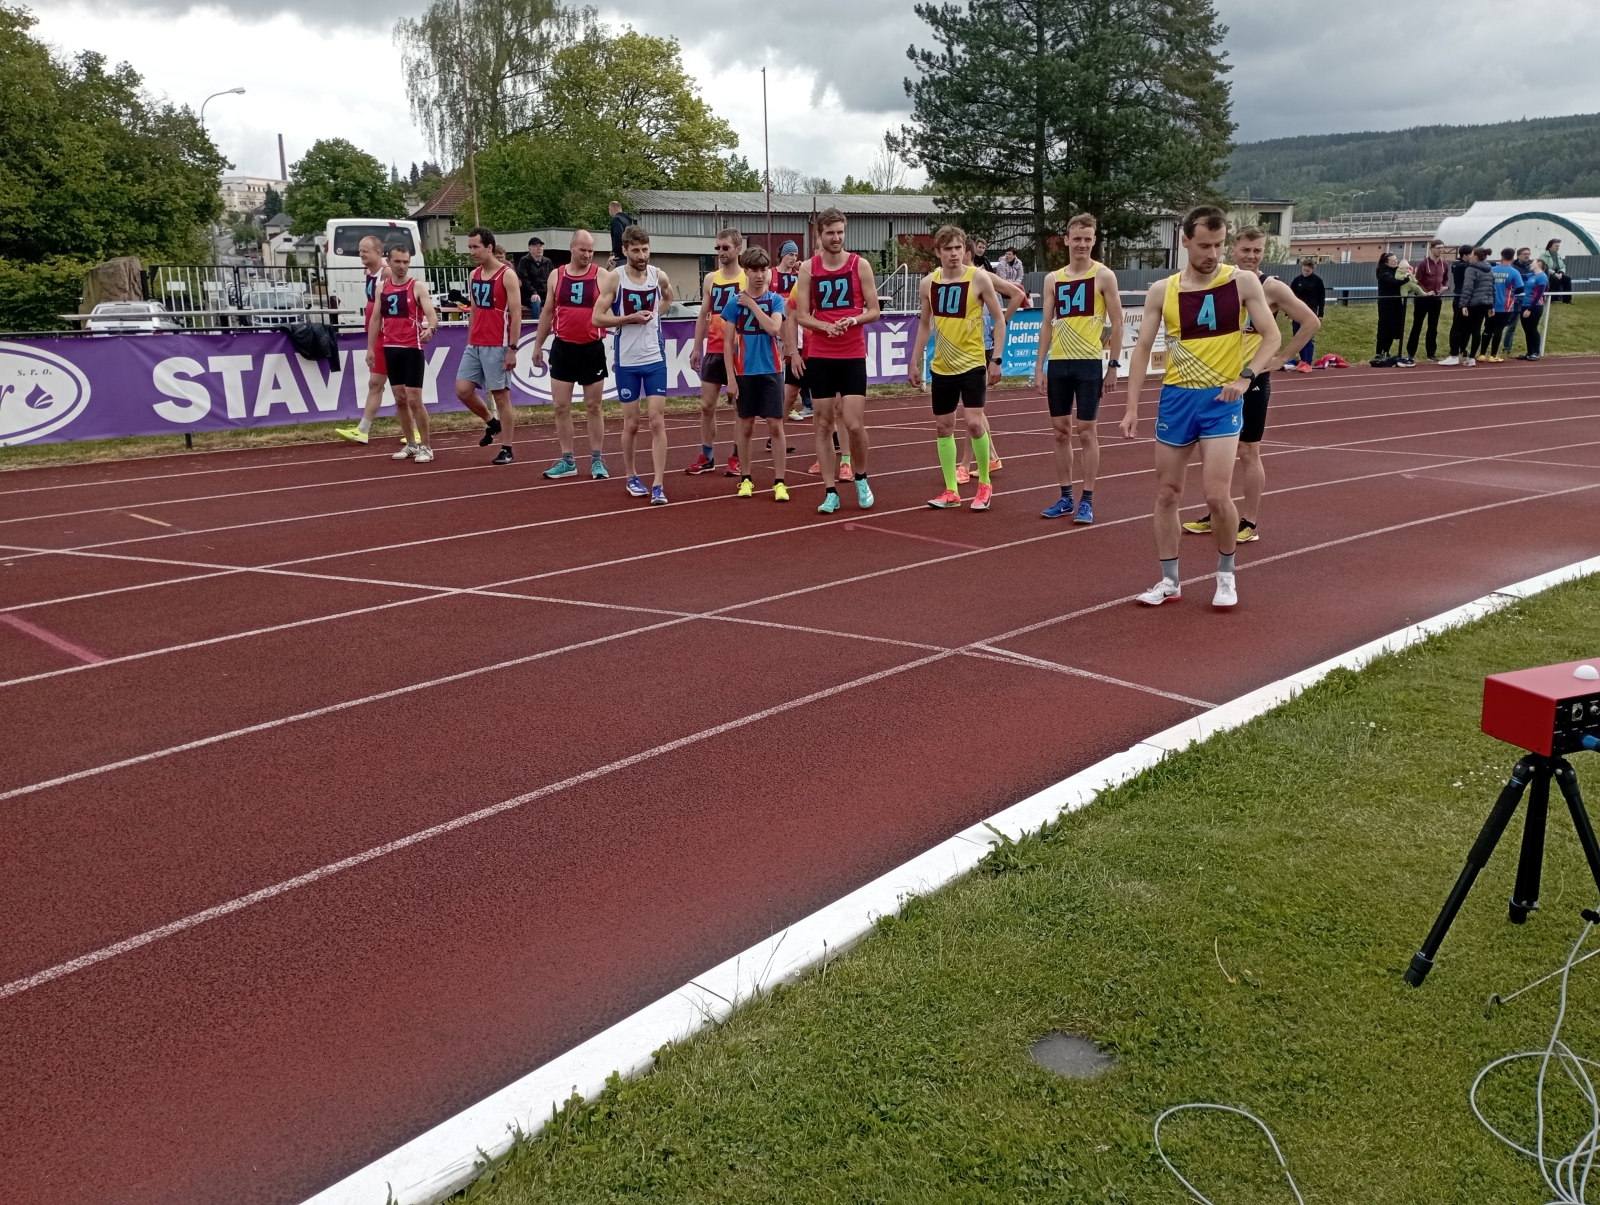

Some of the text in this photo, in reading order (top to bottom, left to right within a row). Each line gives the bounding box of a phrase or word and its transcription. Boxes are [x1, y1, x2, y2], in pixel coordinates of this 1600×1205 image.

[365, 279, 374, 300] 4
[472, 282, 491, 307] 32
[570, 281, 584, 305] 9
[712, 286, 736, 311] 27
[819, 278, 850, 309] 22
[937, 285, 962, 314] 10
[1058, 282, 1086, 315] 54
[387, 294, 399, 315] 3
[1197, 293, 1217, 331] 4
[1124, 311, 1143, 326] lupa
[30, 368, 38, 376] r.
